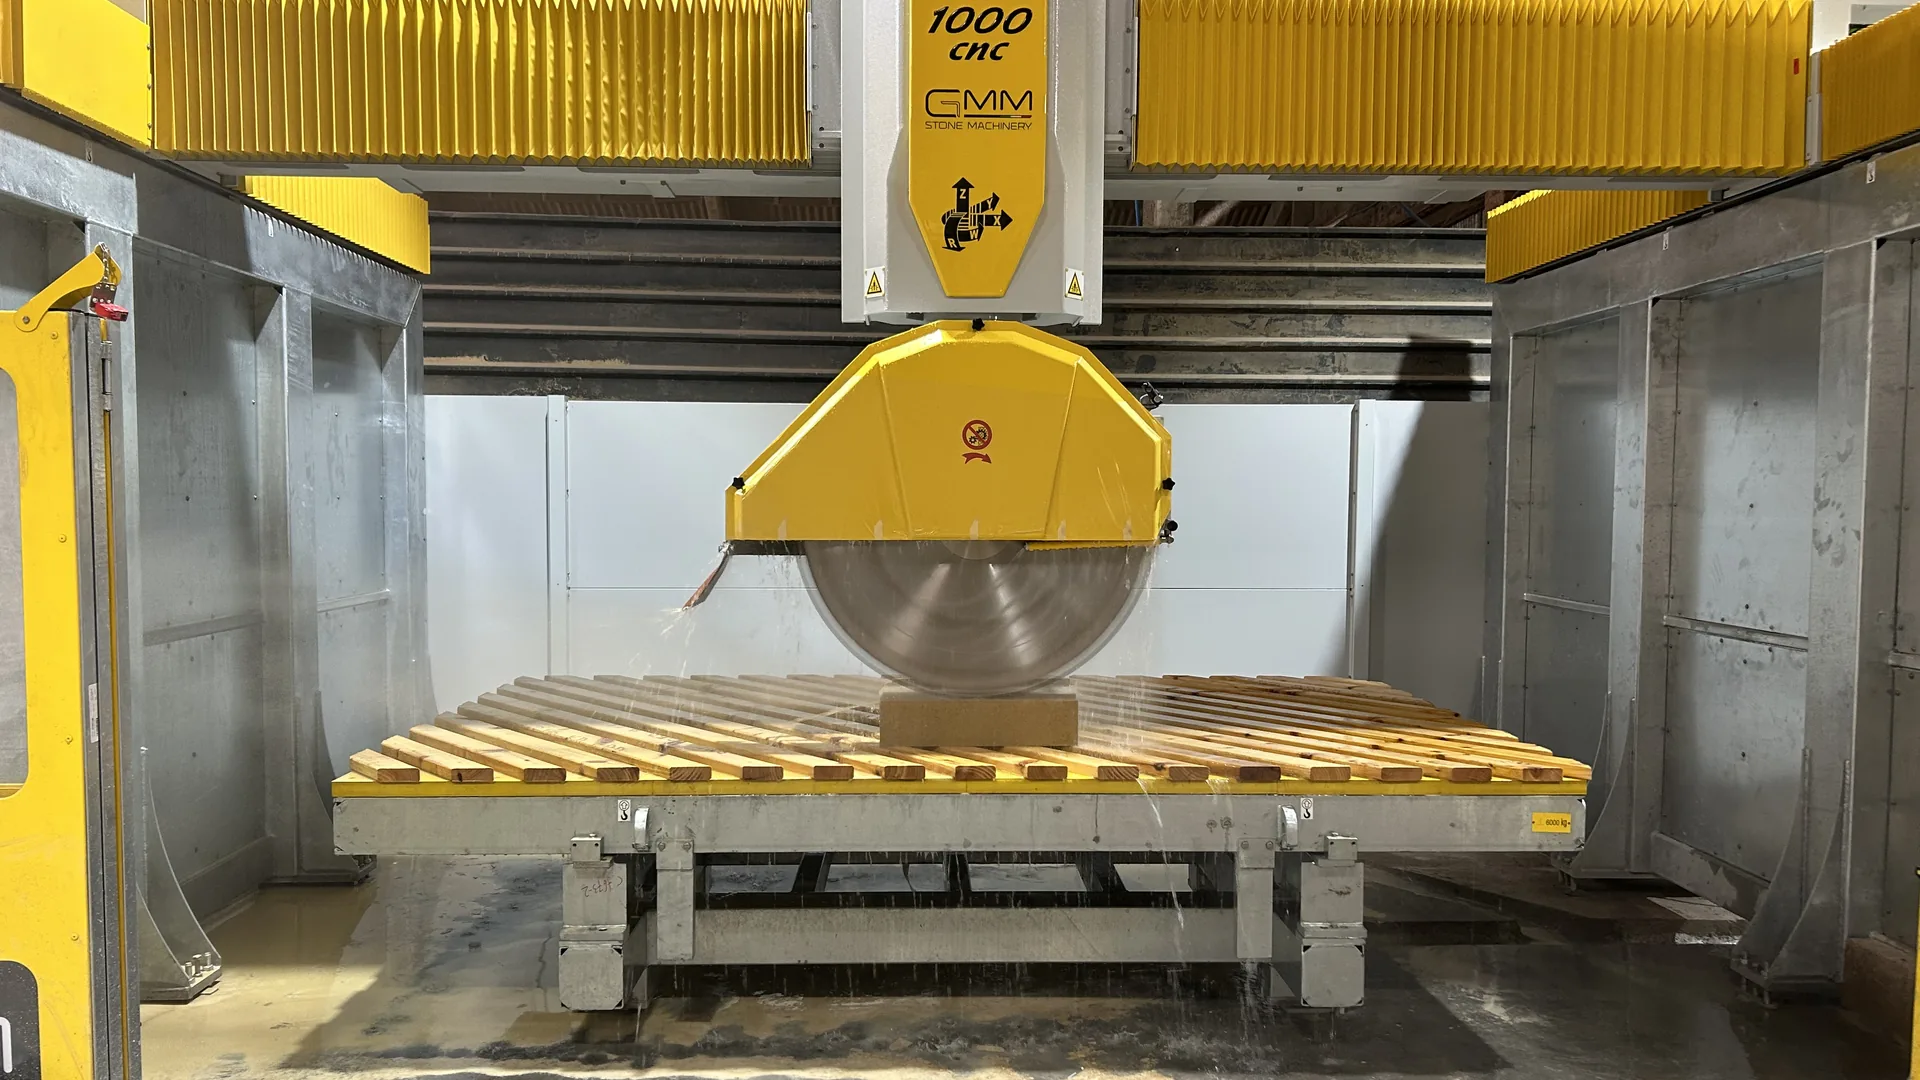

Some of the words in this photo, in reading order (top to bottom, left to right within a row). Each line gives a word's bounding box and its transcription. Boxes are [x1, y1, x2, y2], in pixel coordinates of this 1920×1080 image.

[928, 6, 1033, 34] 1000
[949, 42, 1010, 61] cnc
[925, 89, 1033, 118] GMM
[925, 121, 963, 130] STONE
[967, 121, 1032, 131] MACHINERY
[959, 188, 967, 199] Z
[986, 198, 994, 209] Y
[993, 215, 1001, 226] X
[969, 229, 979, 240] W
[947, 238, 958, 249] R
